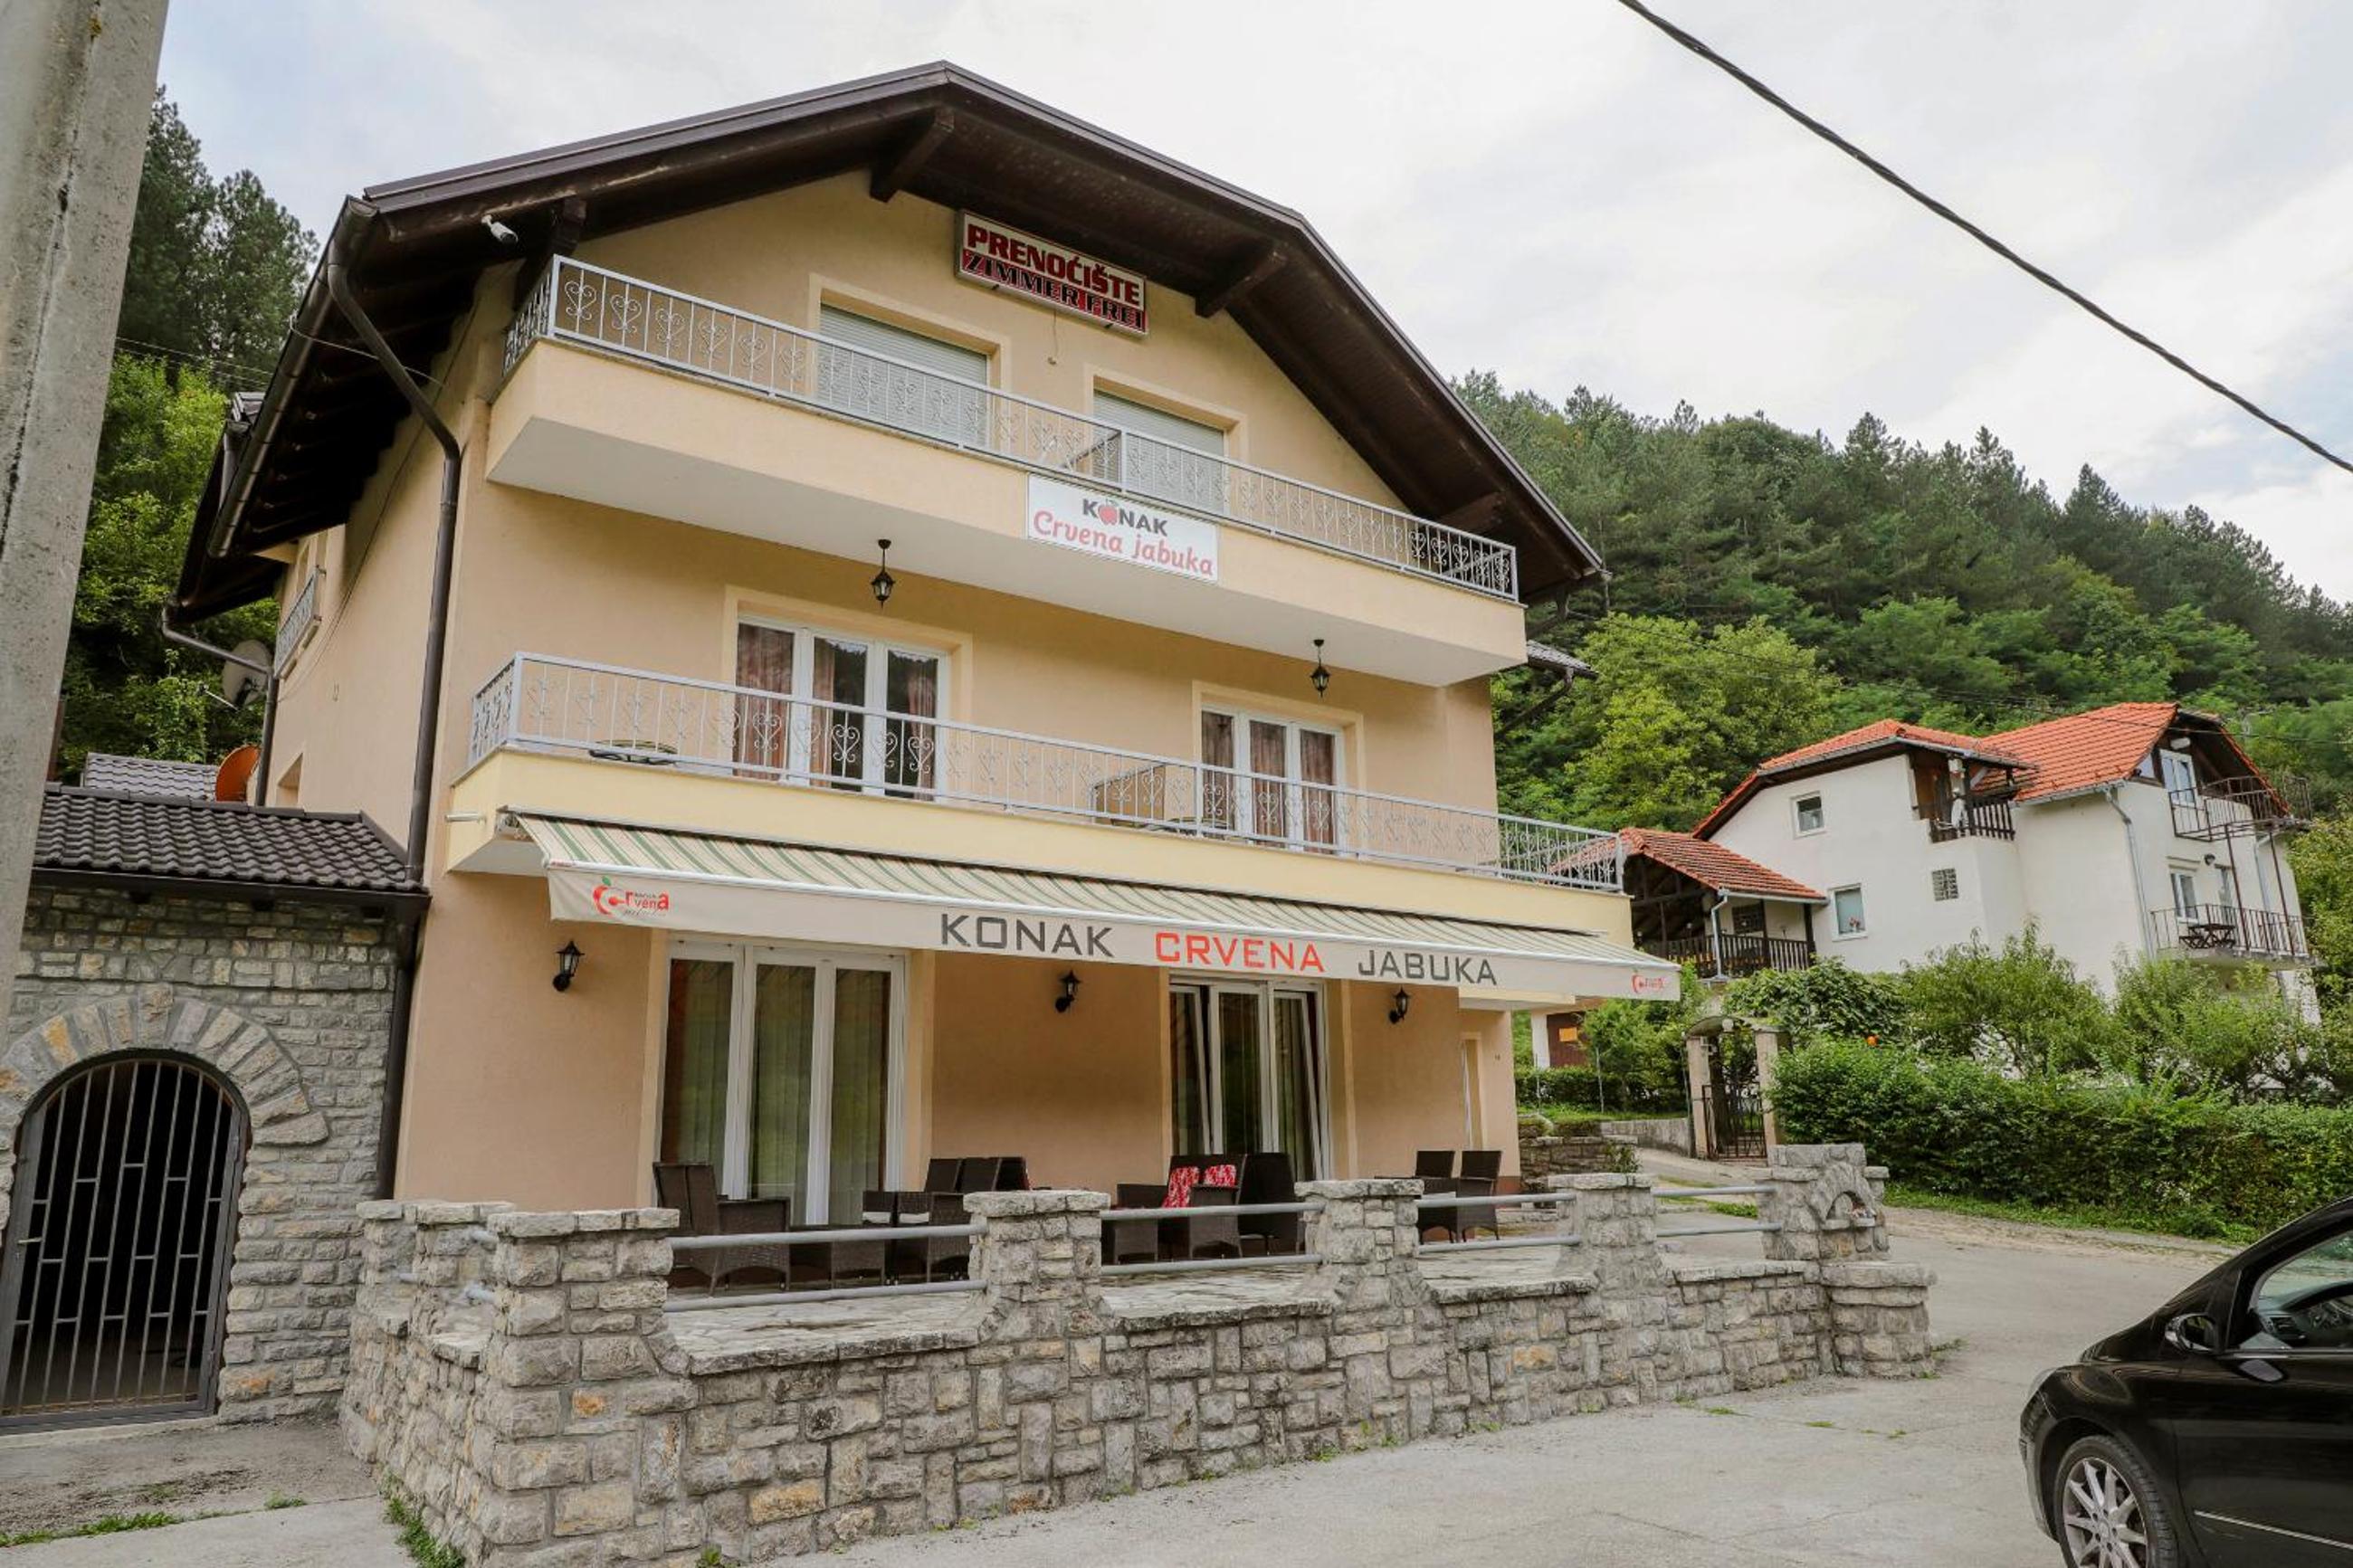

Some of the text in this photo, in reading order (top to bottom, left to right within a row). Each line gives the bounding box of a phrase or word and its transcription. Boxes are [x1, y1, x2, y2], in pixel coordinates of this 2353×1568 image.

[965, 252, 1144, 331] ZIMMER FREI
[967, 223, 1139, 305] PRENOĆIŠTE
[1034, 510, 1213, 575] Crvena jabuka
[940, 913, 1497, 986] KONAK CRVENA JABUKA
